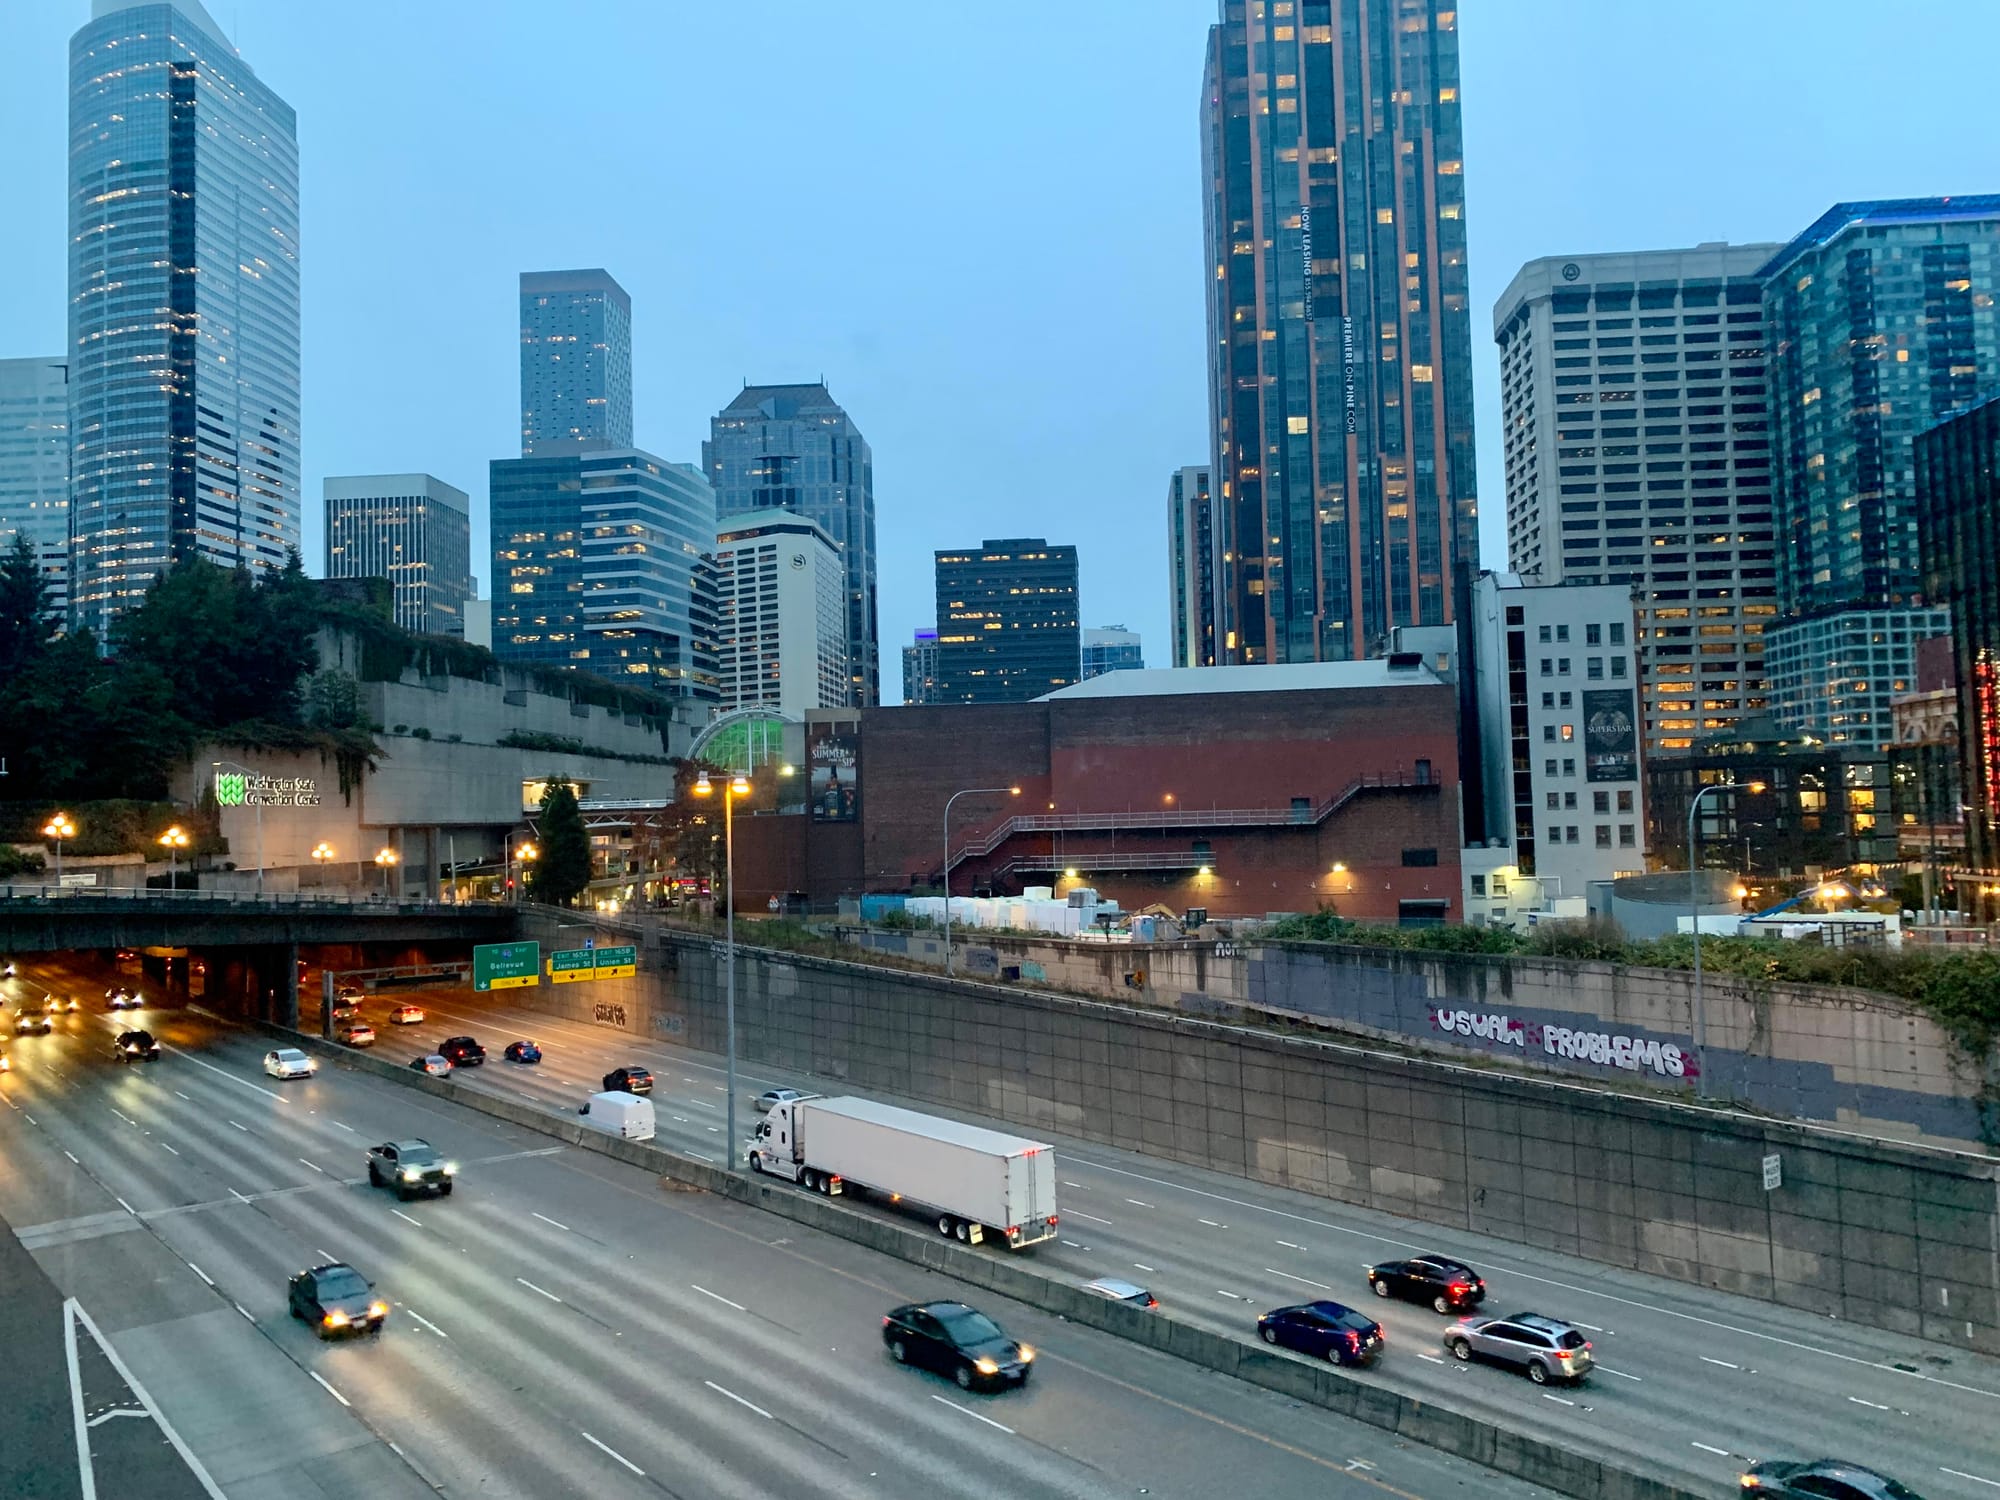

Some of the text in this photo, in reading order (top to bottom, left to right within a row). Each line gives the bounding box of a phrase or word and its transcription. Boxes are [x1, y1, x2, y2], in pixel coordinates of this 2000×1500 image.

[1301, 206, 1310, 231] NOW
[1302, 234, 1312, 275] LEASING
[1344, 316, 1353, 364] PREMIERE
[1345, 366, 1354, 382] ON
[1588, 725, 1632, 734] SUPERSTAR
[812, 749, 845, 759] SUMMER
[245, 776, 317, 795] Washington State
[245, 791, 320, 807] Convention Center
[585, 939, 593, 949] H
[490, 961, 524, 970] Bellevue
[556, 962, 579, 970] James
[600, 958, 620, 966] Union
[1437, 1009, 1685, 1077] USUAL PROBLEMS
